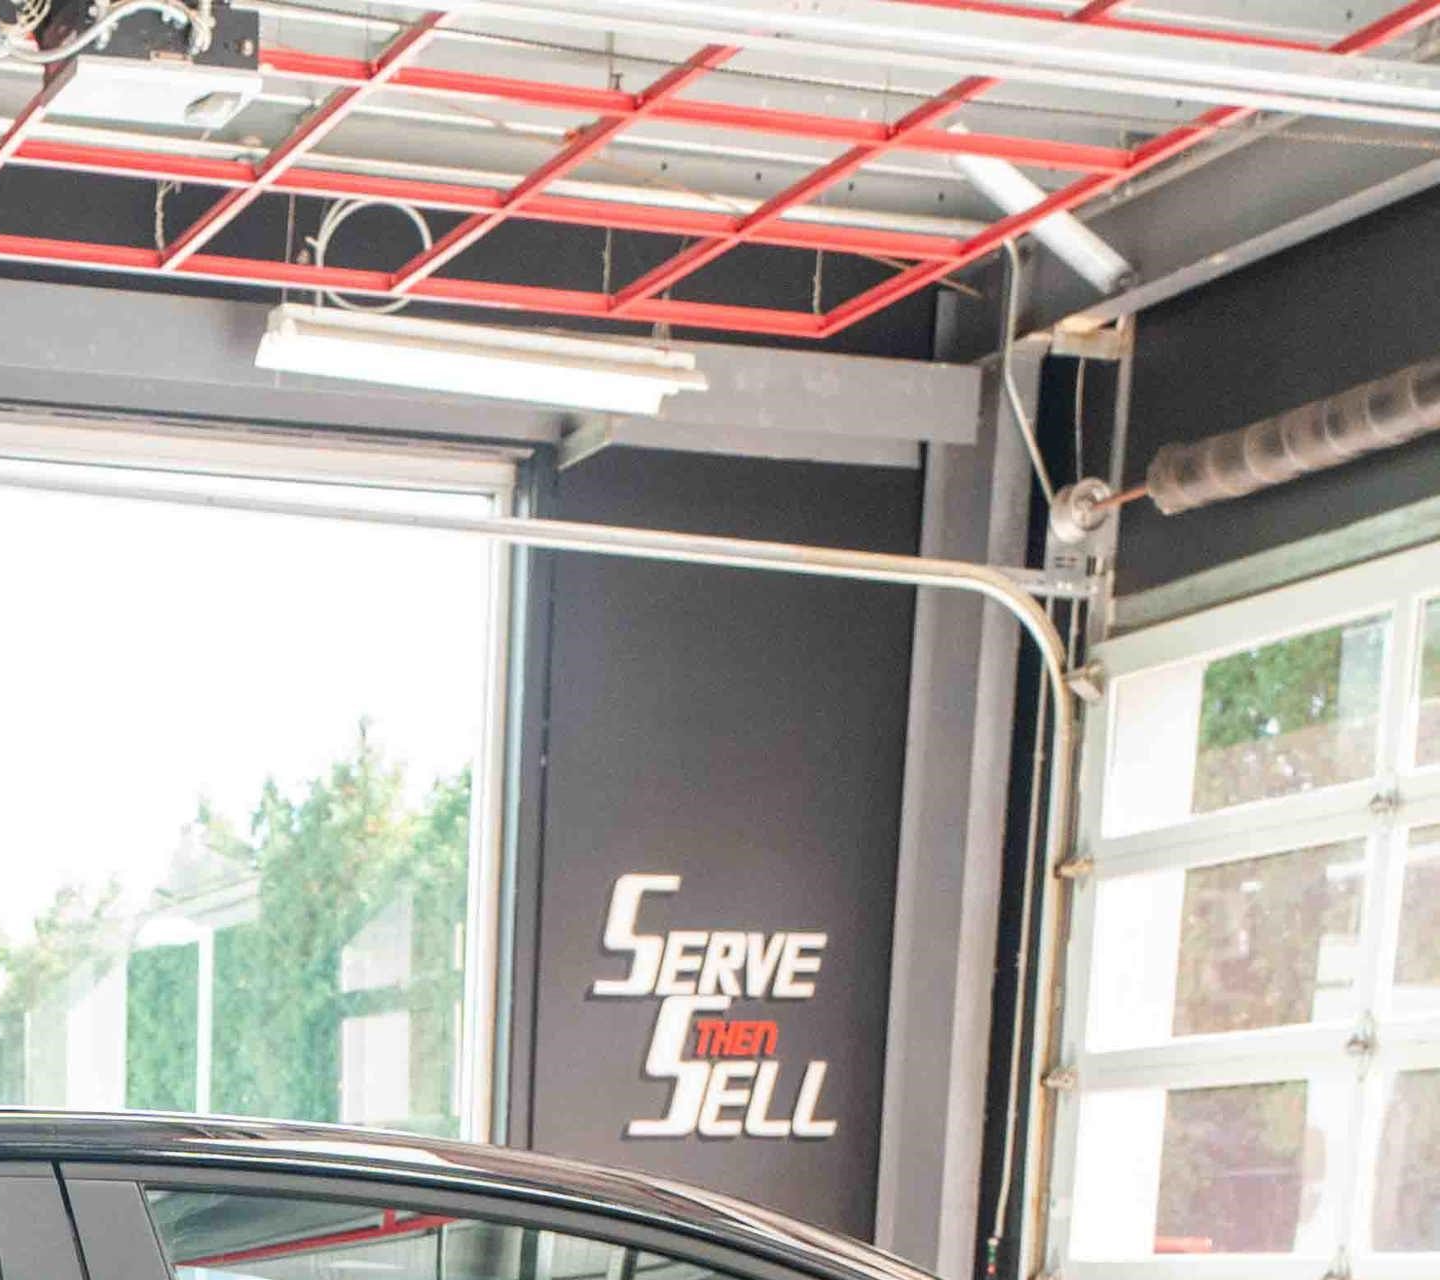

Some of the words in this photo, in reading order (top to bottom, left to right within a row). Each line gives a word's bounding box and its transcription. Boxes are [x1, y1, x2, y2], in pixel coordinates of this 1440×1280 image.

[593, 874, 828, 998] SERVE
[628, 995, 837, 1137] SELL
[696, 1018, 778, 1056] THEN
